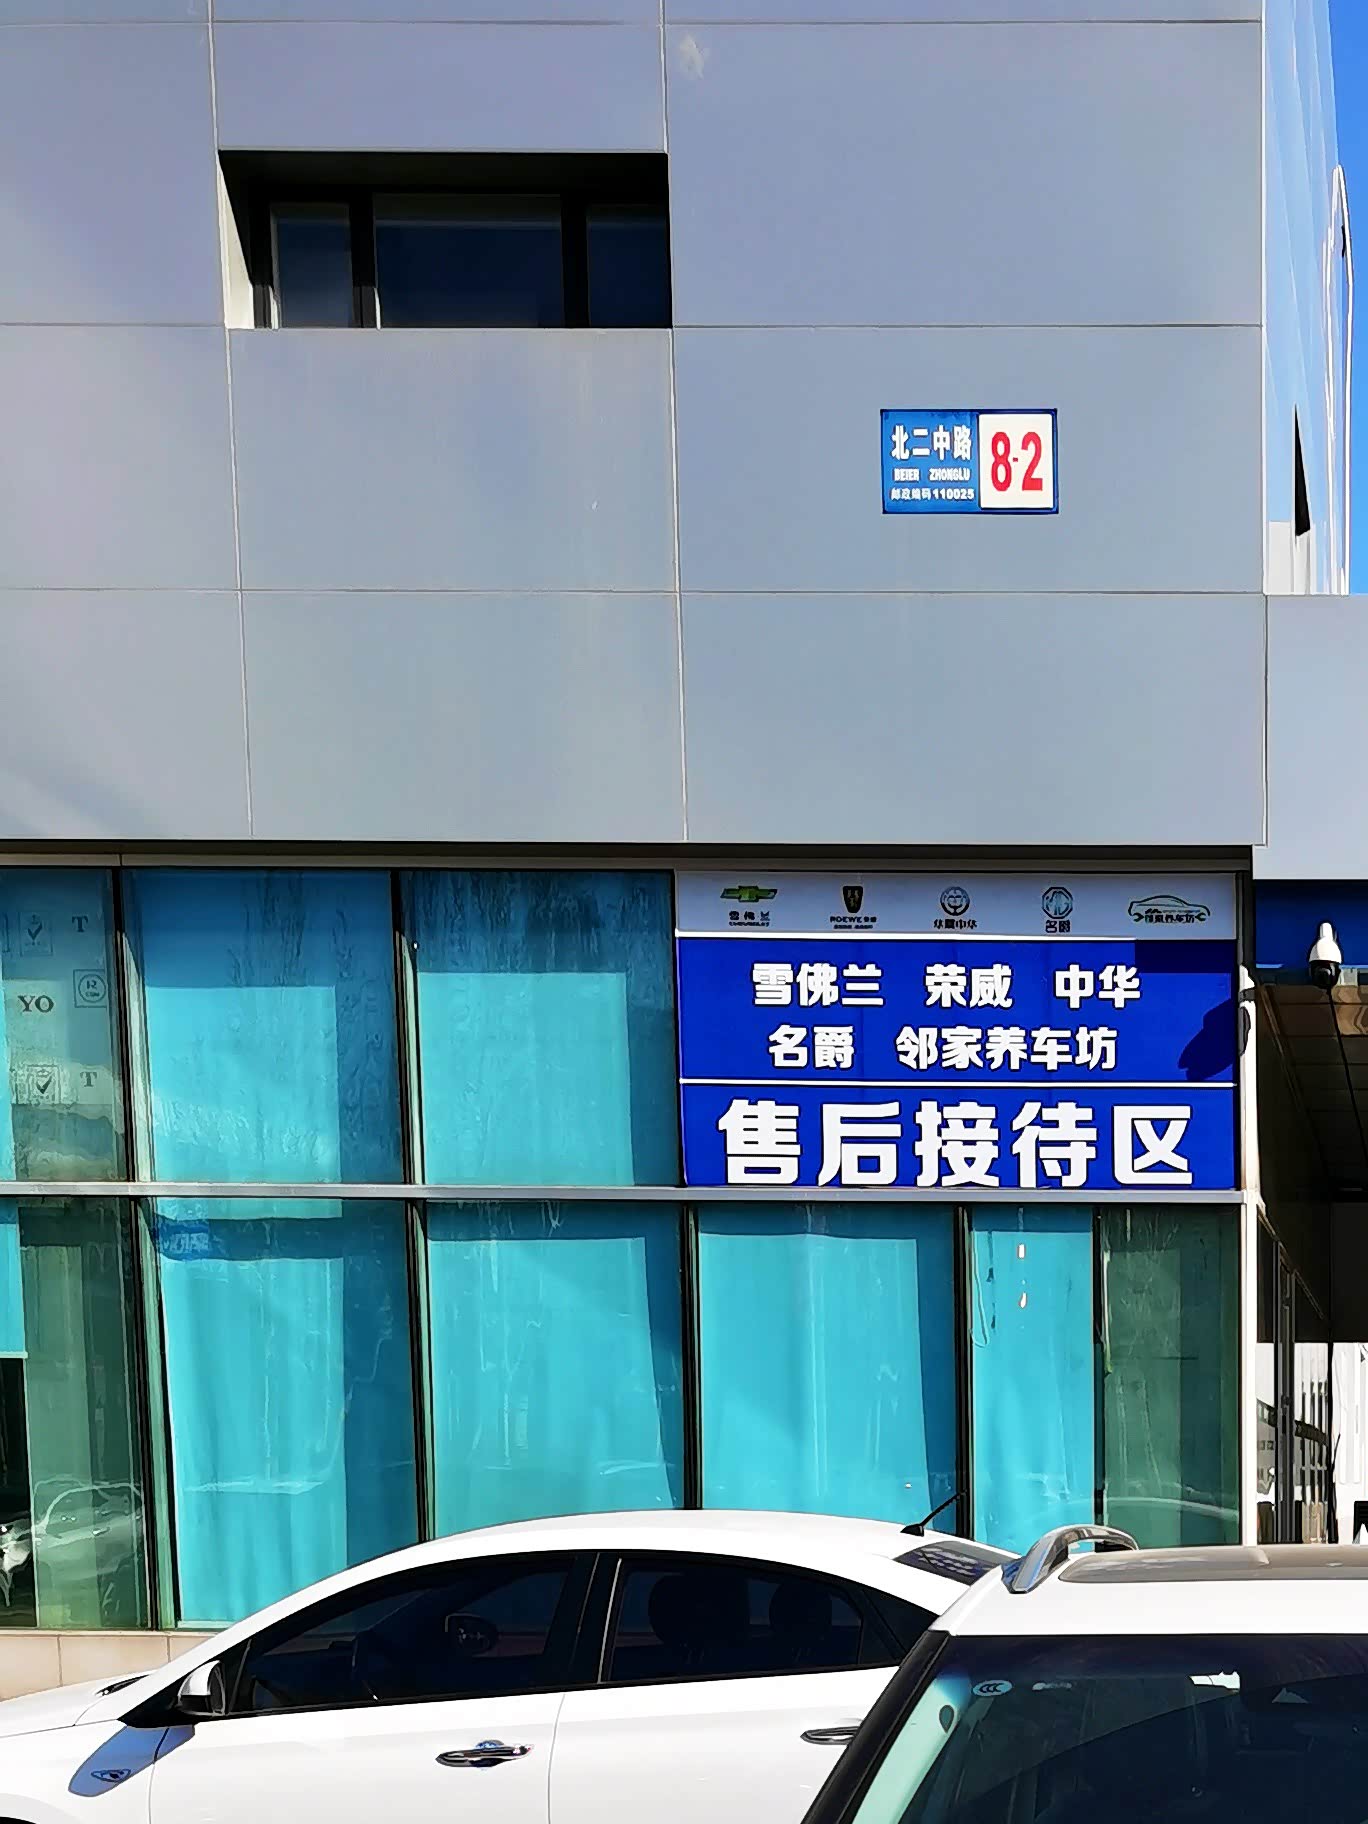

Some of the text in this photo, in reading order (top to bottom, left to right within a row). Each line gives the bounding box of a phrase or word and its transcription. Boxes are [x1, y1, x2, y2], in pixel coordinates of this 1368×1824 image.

[890, 424, 972, 461] 北二中路
[991, 431, 1043, 492] 8-2
[891, 488, 975, 501] 邮政编码110025
[894, 468, 971, 481] BEIER ZHONGLU
[751, 962, 1141, 1010] 雪佛兰 荣威 中华
[768, 1024, 1117, 1071] 名爵 邻家养车坊
[718, 1098, 1195, 1189] 售后接待区
